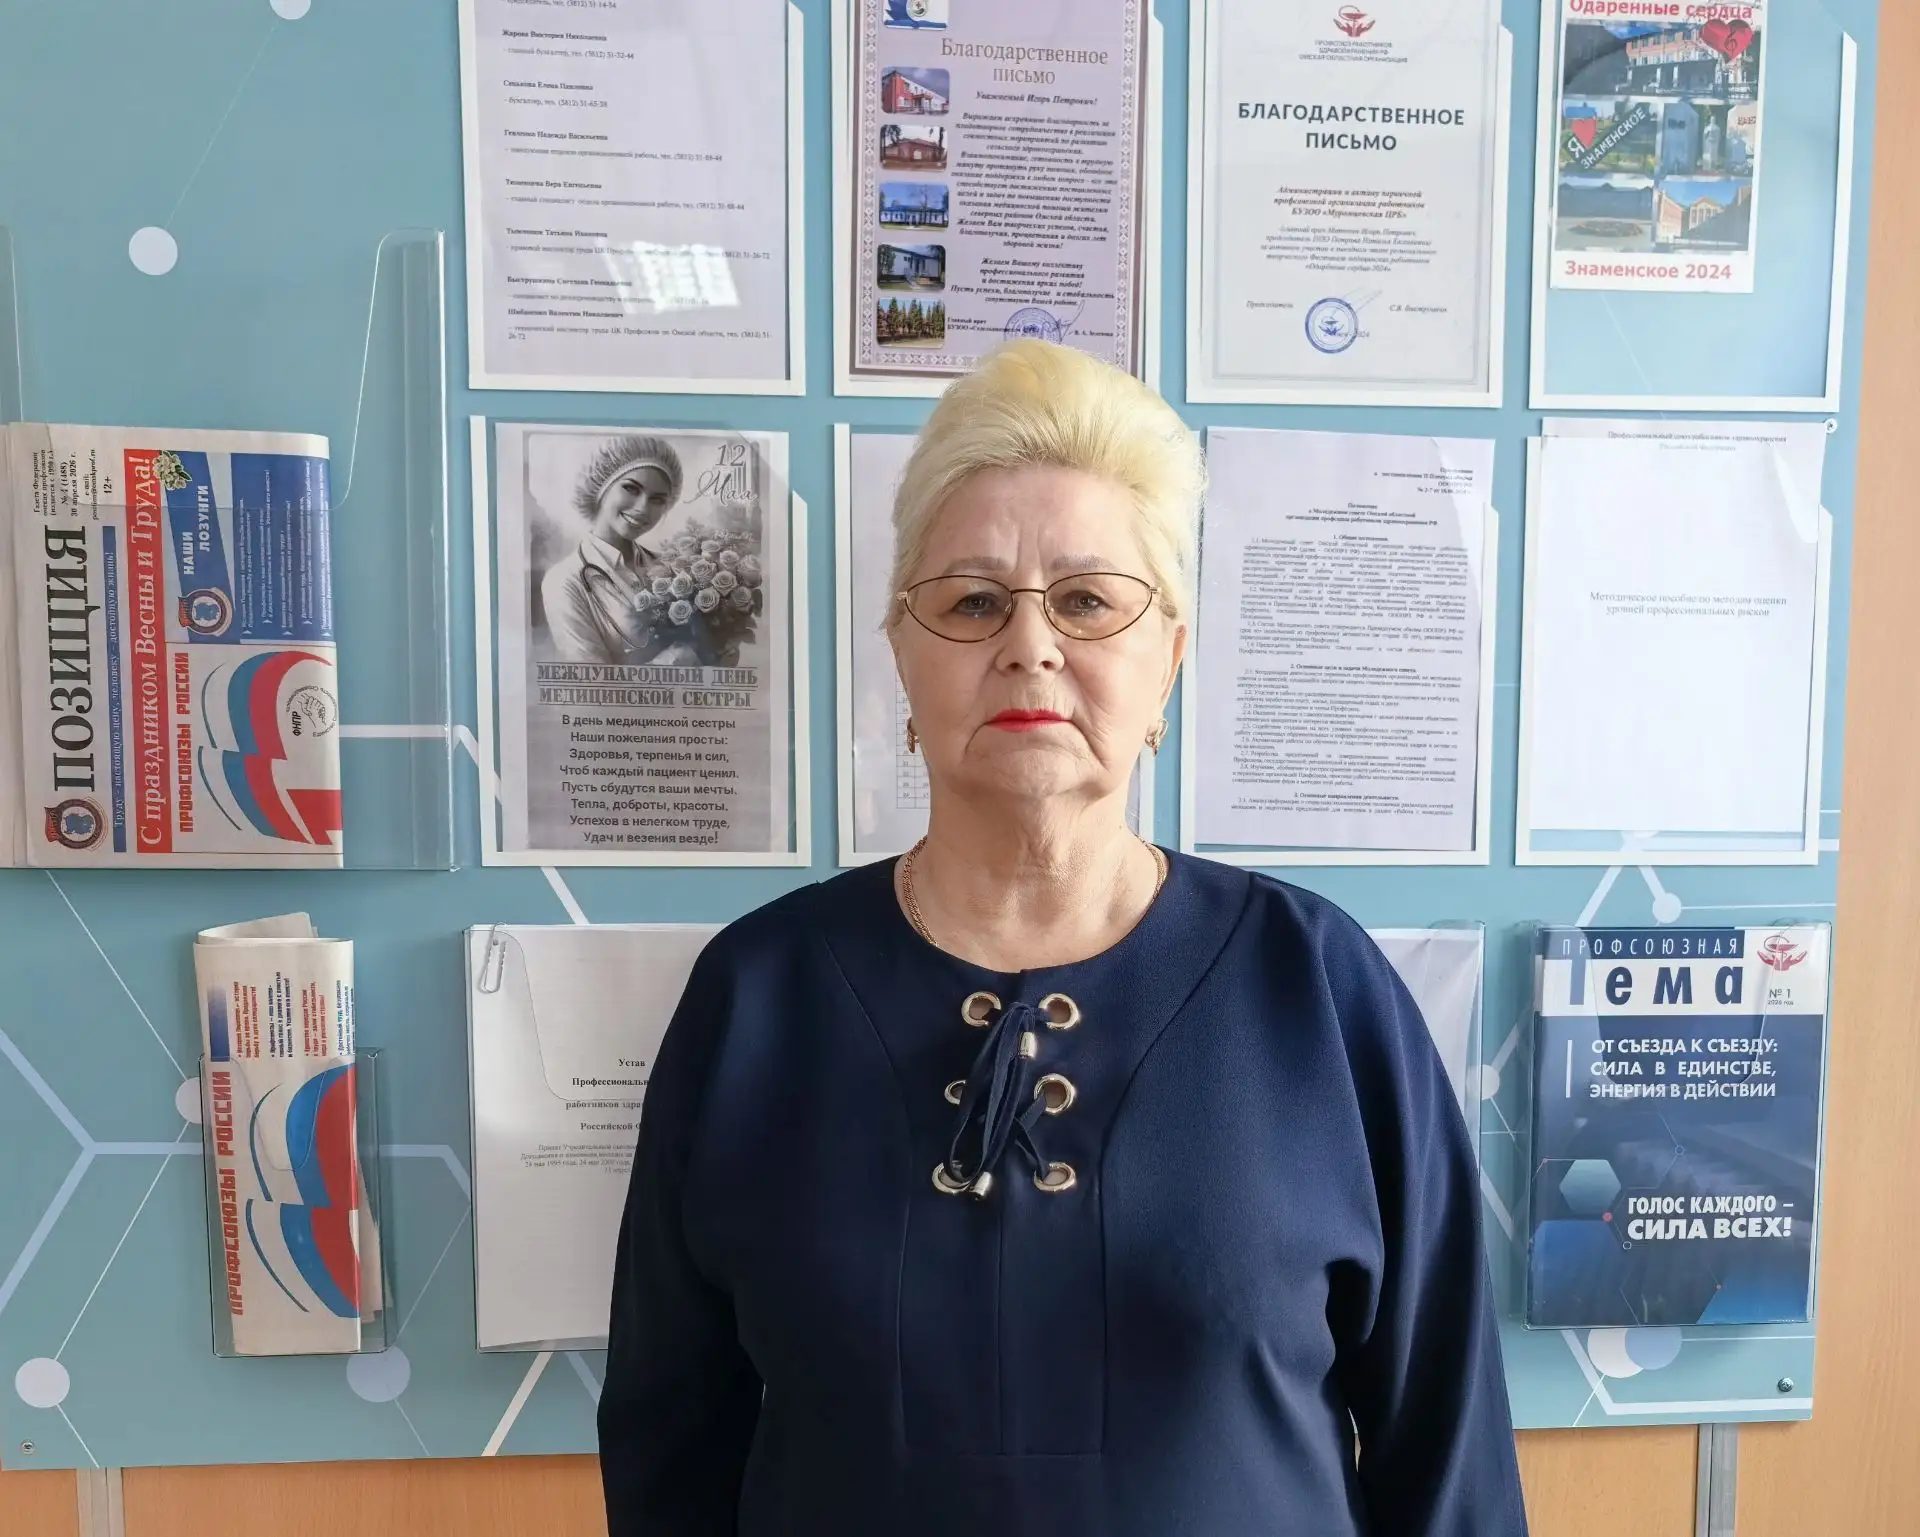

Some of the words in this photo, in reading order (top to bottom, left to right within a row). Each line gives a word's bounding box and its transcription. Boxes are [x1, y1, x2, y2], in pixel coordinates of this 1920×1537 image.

[1570, 0, 1680, 17] Одаренные
[1685, 4, 1752, 20] сердца
[940, 38, 1109, 64] Благодарственное
[1238, 102, 1465, 126] БЛАГОДАРСТВЕННОЕ
[1305, 132, 1397, 151] ПИСЬМО
[1567, 136, 1585, 158] Я
[1580, 107, 1647, 169] ЗНАМЕНСКОЕ
[1565, 260, 1679, 278] Знаменское
[1685, 263, 1732, 280] 2024
[715, 444, 746, 466] 12
[69, 460, 77, 477] 2026
[71, 479, 79, 506] апреля
[103, 475, 112, 494] 12+
[61, 495, 68, 505] №
[128, 456, 158, 543] Труда!
[71, 508, 78, 517] 30
[197, 485, 210, 552] ЛОЗУНГИ
[138, 551, 153, 568] и
[182, 531, 194, 575] НАШИ
[104, 551, 116, 587] жизнь!
[1589, 591, 1657, 603] Методическое
[1659, 593, 1697, 604] пособие
[1698, 595, 1711, 605] по
[1753, 597, 1787, 606] оценки
[106, 588, 119, 644] достойную
[134, 571, 157, 657] Весны
[1605, 603, 1643, 615] уровней
[1647, 605, 1736, 617] профессиональных
[1737, 608, 1770, 617] рисков
[44, 524, 101, 792] ПОЗИЦИЯ
[109, 654, 121, 699] человеку
[174, 652, 190, 714] РОССИИ
[537, 665, 704, 685] МЕЖДУНАРОДНЫЙ
[711, 669, 758, 685] ДЕНЬ
[538, 687, 674, 706] МЕДИЦИНСКОЙ
[682, 691, 752, 707] СЕСТРЫ
[110, 701, 122, 728] цену,
[291, 711, 302, 737] ФНПР
[561, 714, 571, 725] В
[573, 716, 603, 727] день
[605, 715, 688, 729] медицинской
[691, 719, 736, 730] сестры
[138, 662, 166, 821] праздником
[570, 731, 605, 743] Наши
[607, 733, 676, 745] пожелания
[678, 735, 729, 747] просты:
[111, 732, 124, 787] настоящую
[568, 748, 633, 762] Здоровья,
[636, 751, 692, 764] терпенья
[695, 752, 703, 762] и
[704, 752, 730, 763] сил,
[175, 724, 194, 833] ПРОФСОЮЗЫ
[559, 764, 590, 776] Чтоб
[592, 765, 644, 779] каждый
[646, 768, 698, 780] пациент
[699, 769, 740, 780] ценил.
[561, 781, 597, 794] Пусть
[600, 782, 656, 795] сбудутся
[658, 785, 691, 794] ваши
[693, 786, 738, 796] мечты.
[113, 799, 125, 828] Труду
[570, 798, 609, 811] Тепла,
[612, 799, 670, 812] доброты,
[673, 801, 729, 813] красоты.
[569, 815, 619, 827] Успехов
[621, 818, 629, 826] в
[632, 818, 689, 827] нелегком
[691, 819, 731, 830] труде,
[140, 825, 162, 845] С
[583, 832, 613, 844] Удач
[616, 834, 624, 843] и
[627, 834, 676, 844] везения
[679, 831, 719, 845] везде!
[1562, 938, 1738, 955] ПРОФСОЮЗНАЯ
[1569, 957, 1743, 1006] Тема
[1768, 988, 1783, 999] №
[1785, 988, 1792, 999] 1
[1591, 1039, 1614, 1054] ОТ
[1617, 1038, 1686, 1055] СЪЕЗДА
[1691, 1038, 1702, 1053] К
[1707, 1038, 1778, 1055] СЪЕЗДУ:
[618, 1058, 646, 1067] Устав
[1590, 1061, 1643, 1076] СИЛА
[1655, 1061, 1666, 1075] В
[1678, 1061, 1776, 1077] ЕДИНСТВЕ,
[572, 1077, 649, 1088] Профессиональн
[1589, 1083, 1666, 1098] ЭНЕРГИЯ
[1670, 1083, 1681, 1098] В
[1684, 1080, 1776, 1100] ДЕЙСТВИИ
[211, 1071, 234, 1156] РОССИИ
[565, 1100, 619, 1111] работников
[621, 1102, 641, 1111] здра
[580, 1121, 633, 1131] Российской
[1627, 1196, 1685, 1215] ГОЛОС
[1690, 1195, 1776, 1215] КАЖДОГО
[1627, 1218, 1708, 1240] СИЛА
[1713, 1217, 1792, 1238] ВСЕХ!
[218, 1167, 243, 1316] ПРОФСОЮЗЫ
